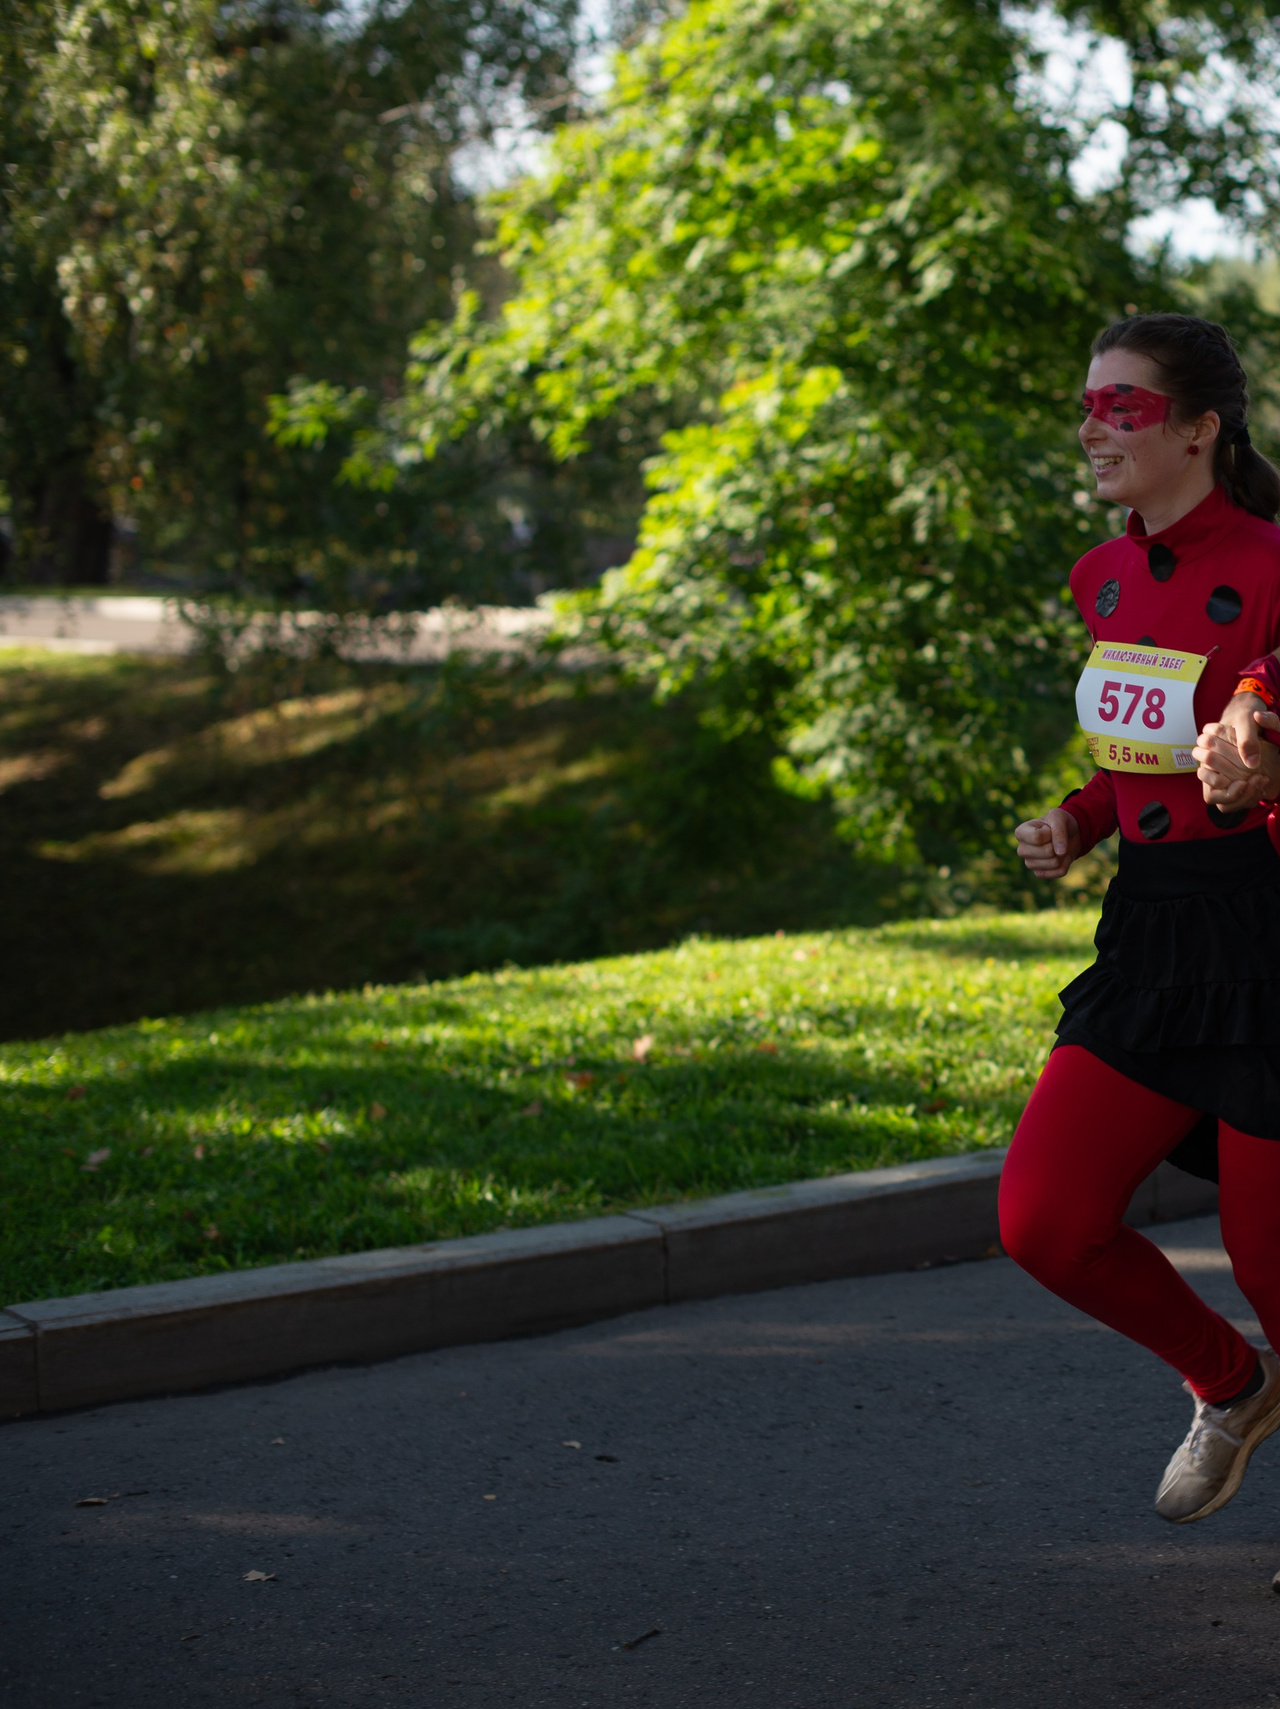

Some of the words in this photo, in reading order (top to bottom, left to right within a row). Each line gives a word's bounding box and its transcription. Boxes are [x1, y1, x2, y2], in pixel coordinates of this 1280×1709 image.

[1101, 648, 1159, 667] ИНКЛЮЗИВНЫЙ
[1158, 656, 1186, 670] ЗАБЕГ
[1098, 680, 1166, 730] 578
[1108, 744, 1132, 765] 5,5
